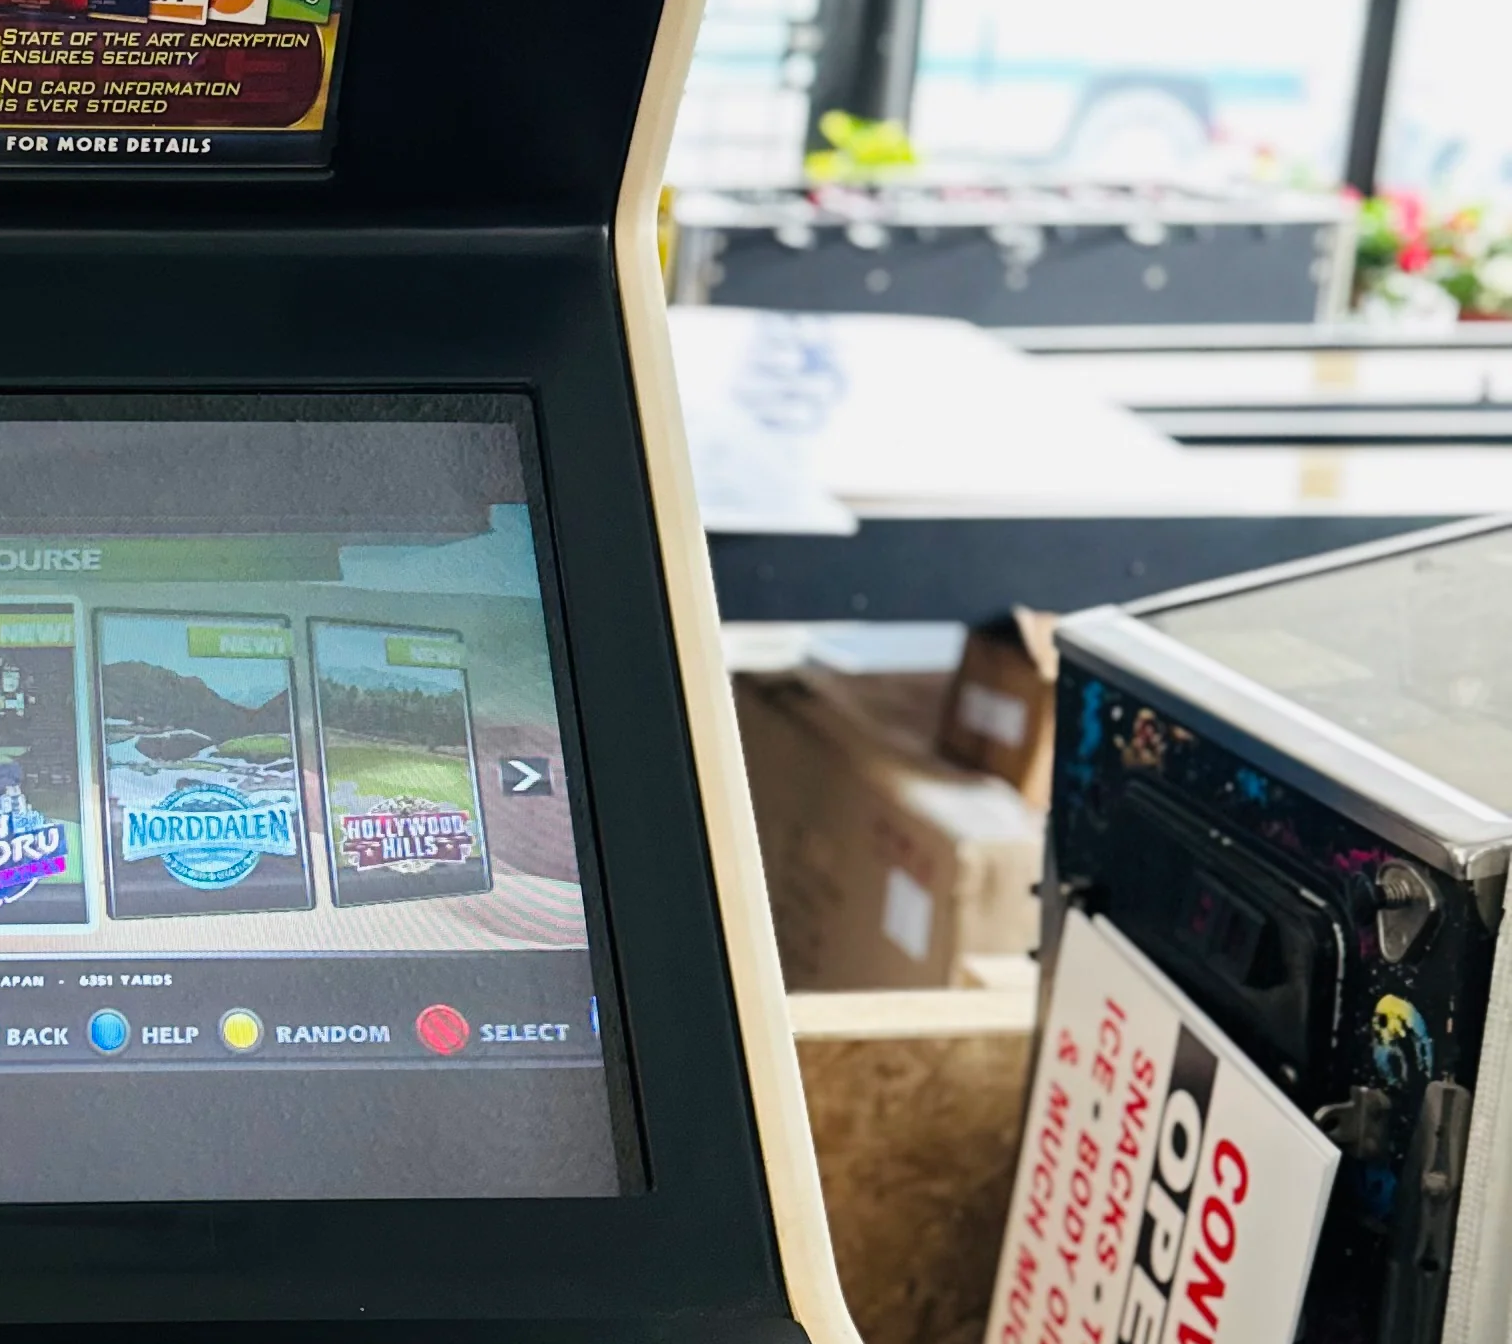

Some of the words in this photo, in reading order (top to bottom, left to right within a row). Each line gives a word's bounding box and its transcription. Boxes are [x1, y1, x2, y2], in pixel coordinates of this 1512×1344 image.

[2, 29, 62, 46] STATE
[70, 31, 94, 47] OF
[103, 32, 141, 47] THE
[146, 32, 182, 47] ART
[190, 33, 310, 48] ENCRYPTION
[0, 50, 94, 65] ENSURES
[101, 51, 200, 66] SECURITY
[0, 78, 32, 95] NO
[40, 80, 96, 95] CARD
[103, 81, 241, 96] INFORMATION
[26, 98, 78, 113] EVER
[86, 99, 168, 114] STORED
[6, 136, 48, 151] FOR
[57, 137, 119, 152] MORE
[126, 137, 212, 153] DETAILS
[129, 809, 290, 847] NORDDALEN
[347, 815, 465, 840] HOLLYWOOD
[382, 835, 439, 859] HILLS
[120, 974, 173, 986] YARDS
[6, 1027, 68, 1046] BACK
[142, 1026, 199, 1045] HELP
[275, 1025, 391, 1044] RANDOM
[480, 1023, 569, 1042] SELECT
[1092, 998, 1127, 1094] ICE
[1094, 1049, 1157, 1274] SNACKS
[1057, 1128, 1101, 1283] BODY
